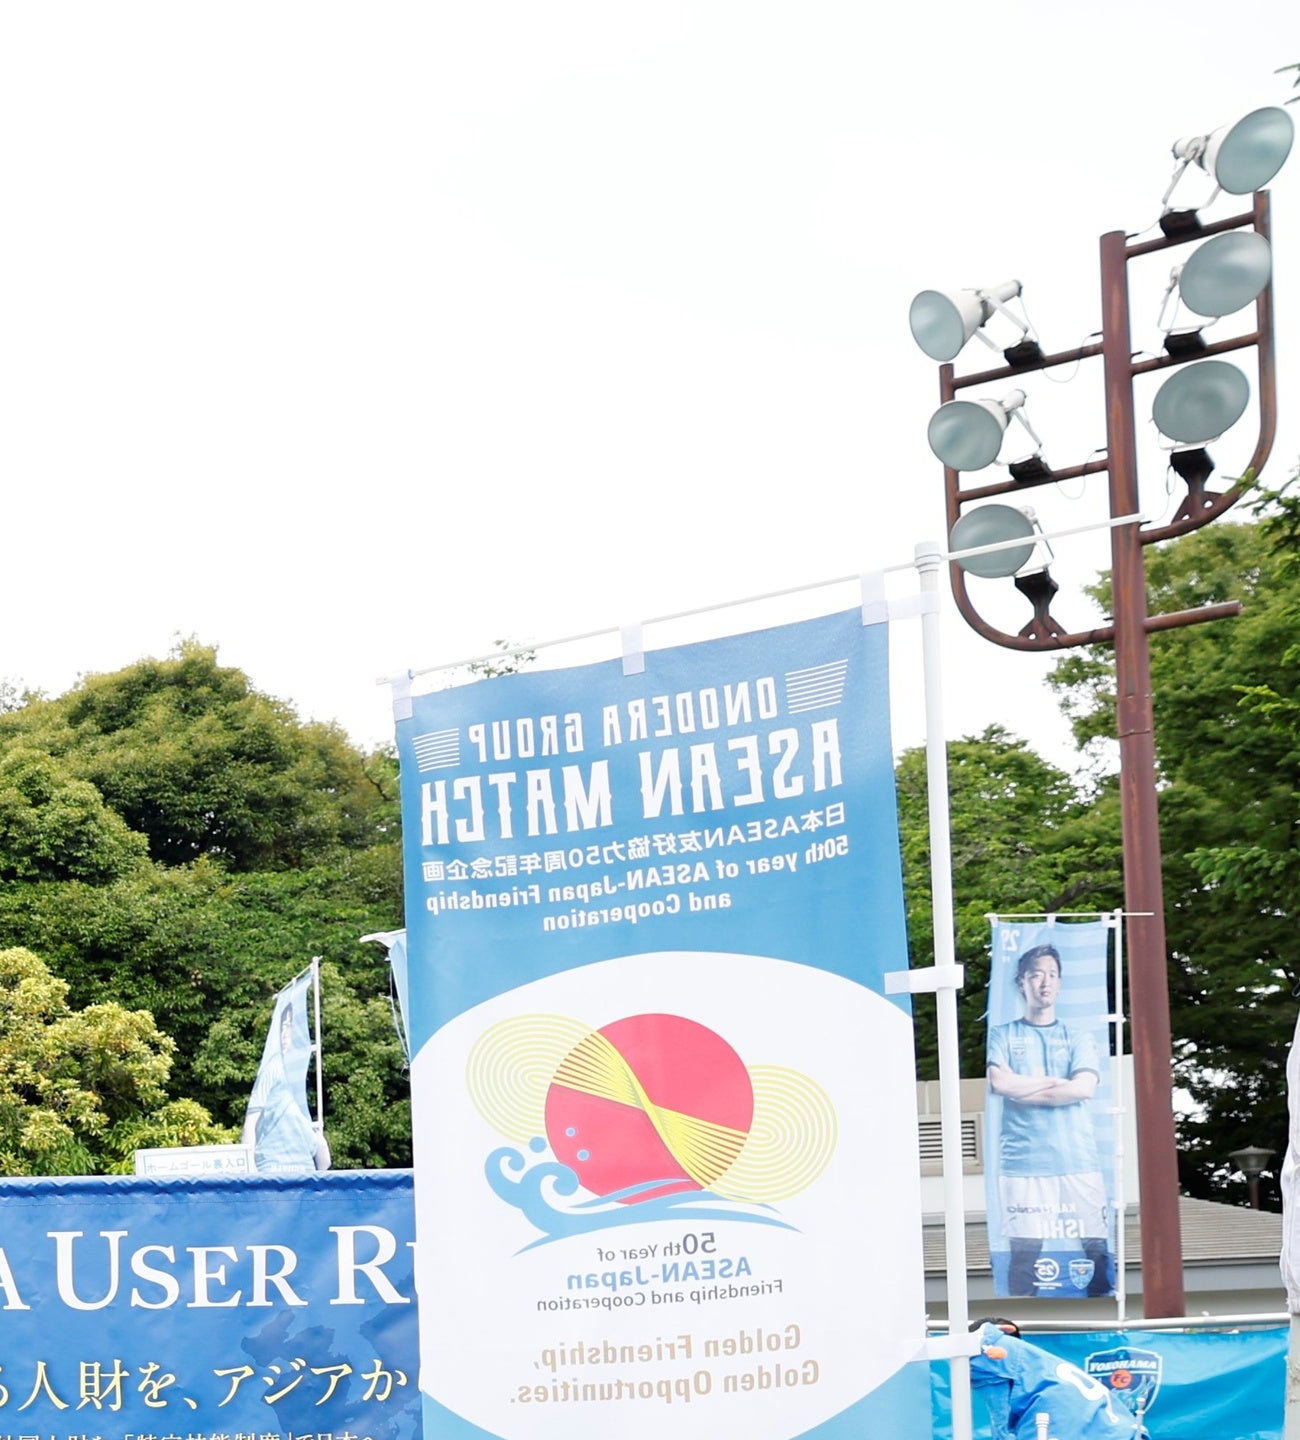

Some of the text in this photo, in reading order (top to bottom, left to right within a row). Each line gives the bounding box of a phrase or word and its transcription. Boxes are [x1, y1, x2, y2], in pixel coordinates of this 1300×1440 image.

[46, 1230, 307, 1308] USER
[328, 1223, 416, 1306] R
[1088, 1359, 1158, 1372] YOKOHAMA
